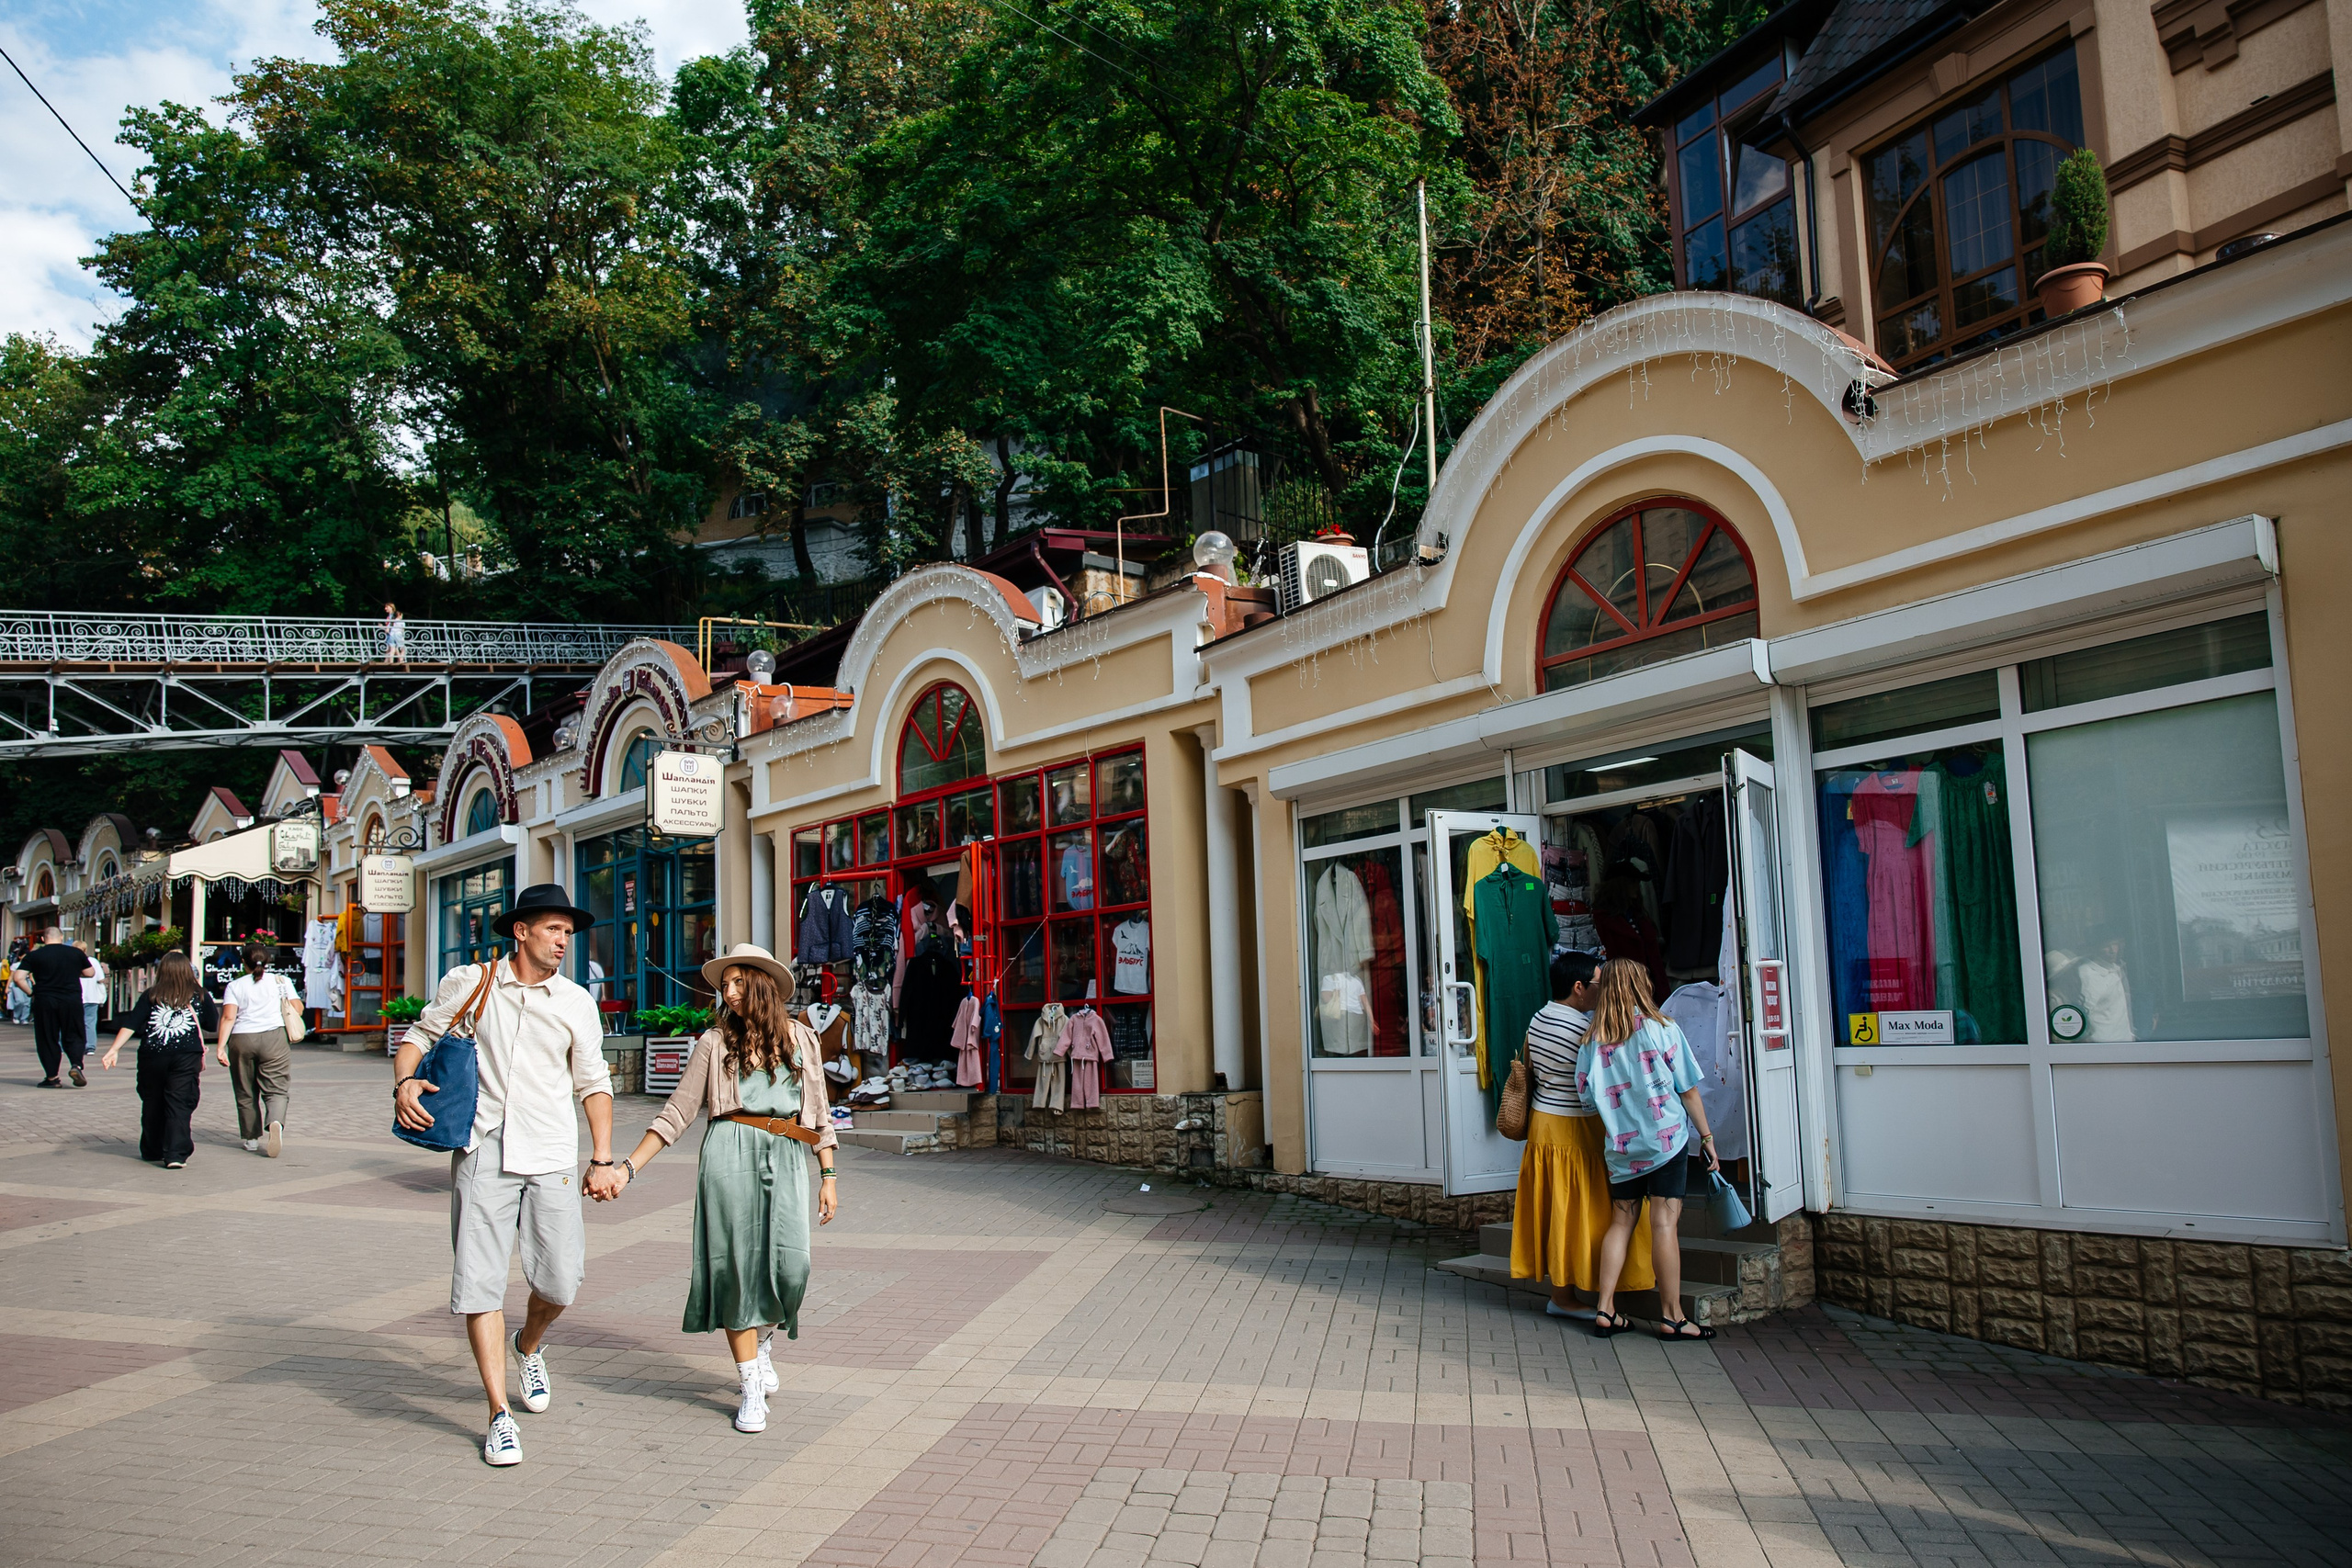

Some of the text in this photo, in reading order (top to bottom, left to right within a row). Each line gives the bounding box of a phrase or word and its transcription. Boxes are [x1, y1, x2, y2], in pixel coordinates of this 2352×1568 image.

[671, 785, 707, 795] ШАПКИ
[671, 797, 707, 806] ШУБКИ
[670, 808, 708, 817] ПАЛЬТО
[662, 818, 717, 828] АКСЕССУАРЫ
[1071, 888, 1093, 898] ЭЛЬБР
[205, 963, 244, 976] Стары
[217, 973, 235, 983] Бак
[1888, 1020, 1944, 1030] Max Moda
[1645, 1077, 1661, 1089] INTERNET
[1651, 1079, 1666, 1090] INTERNET
